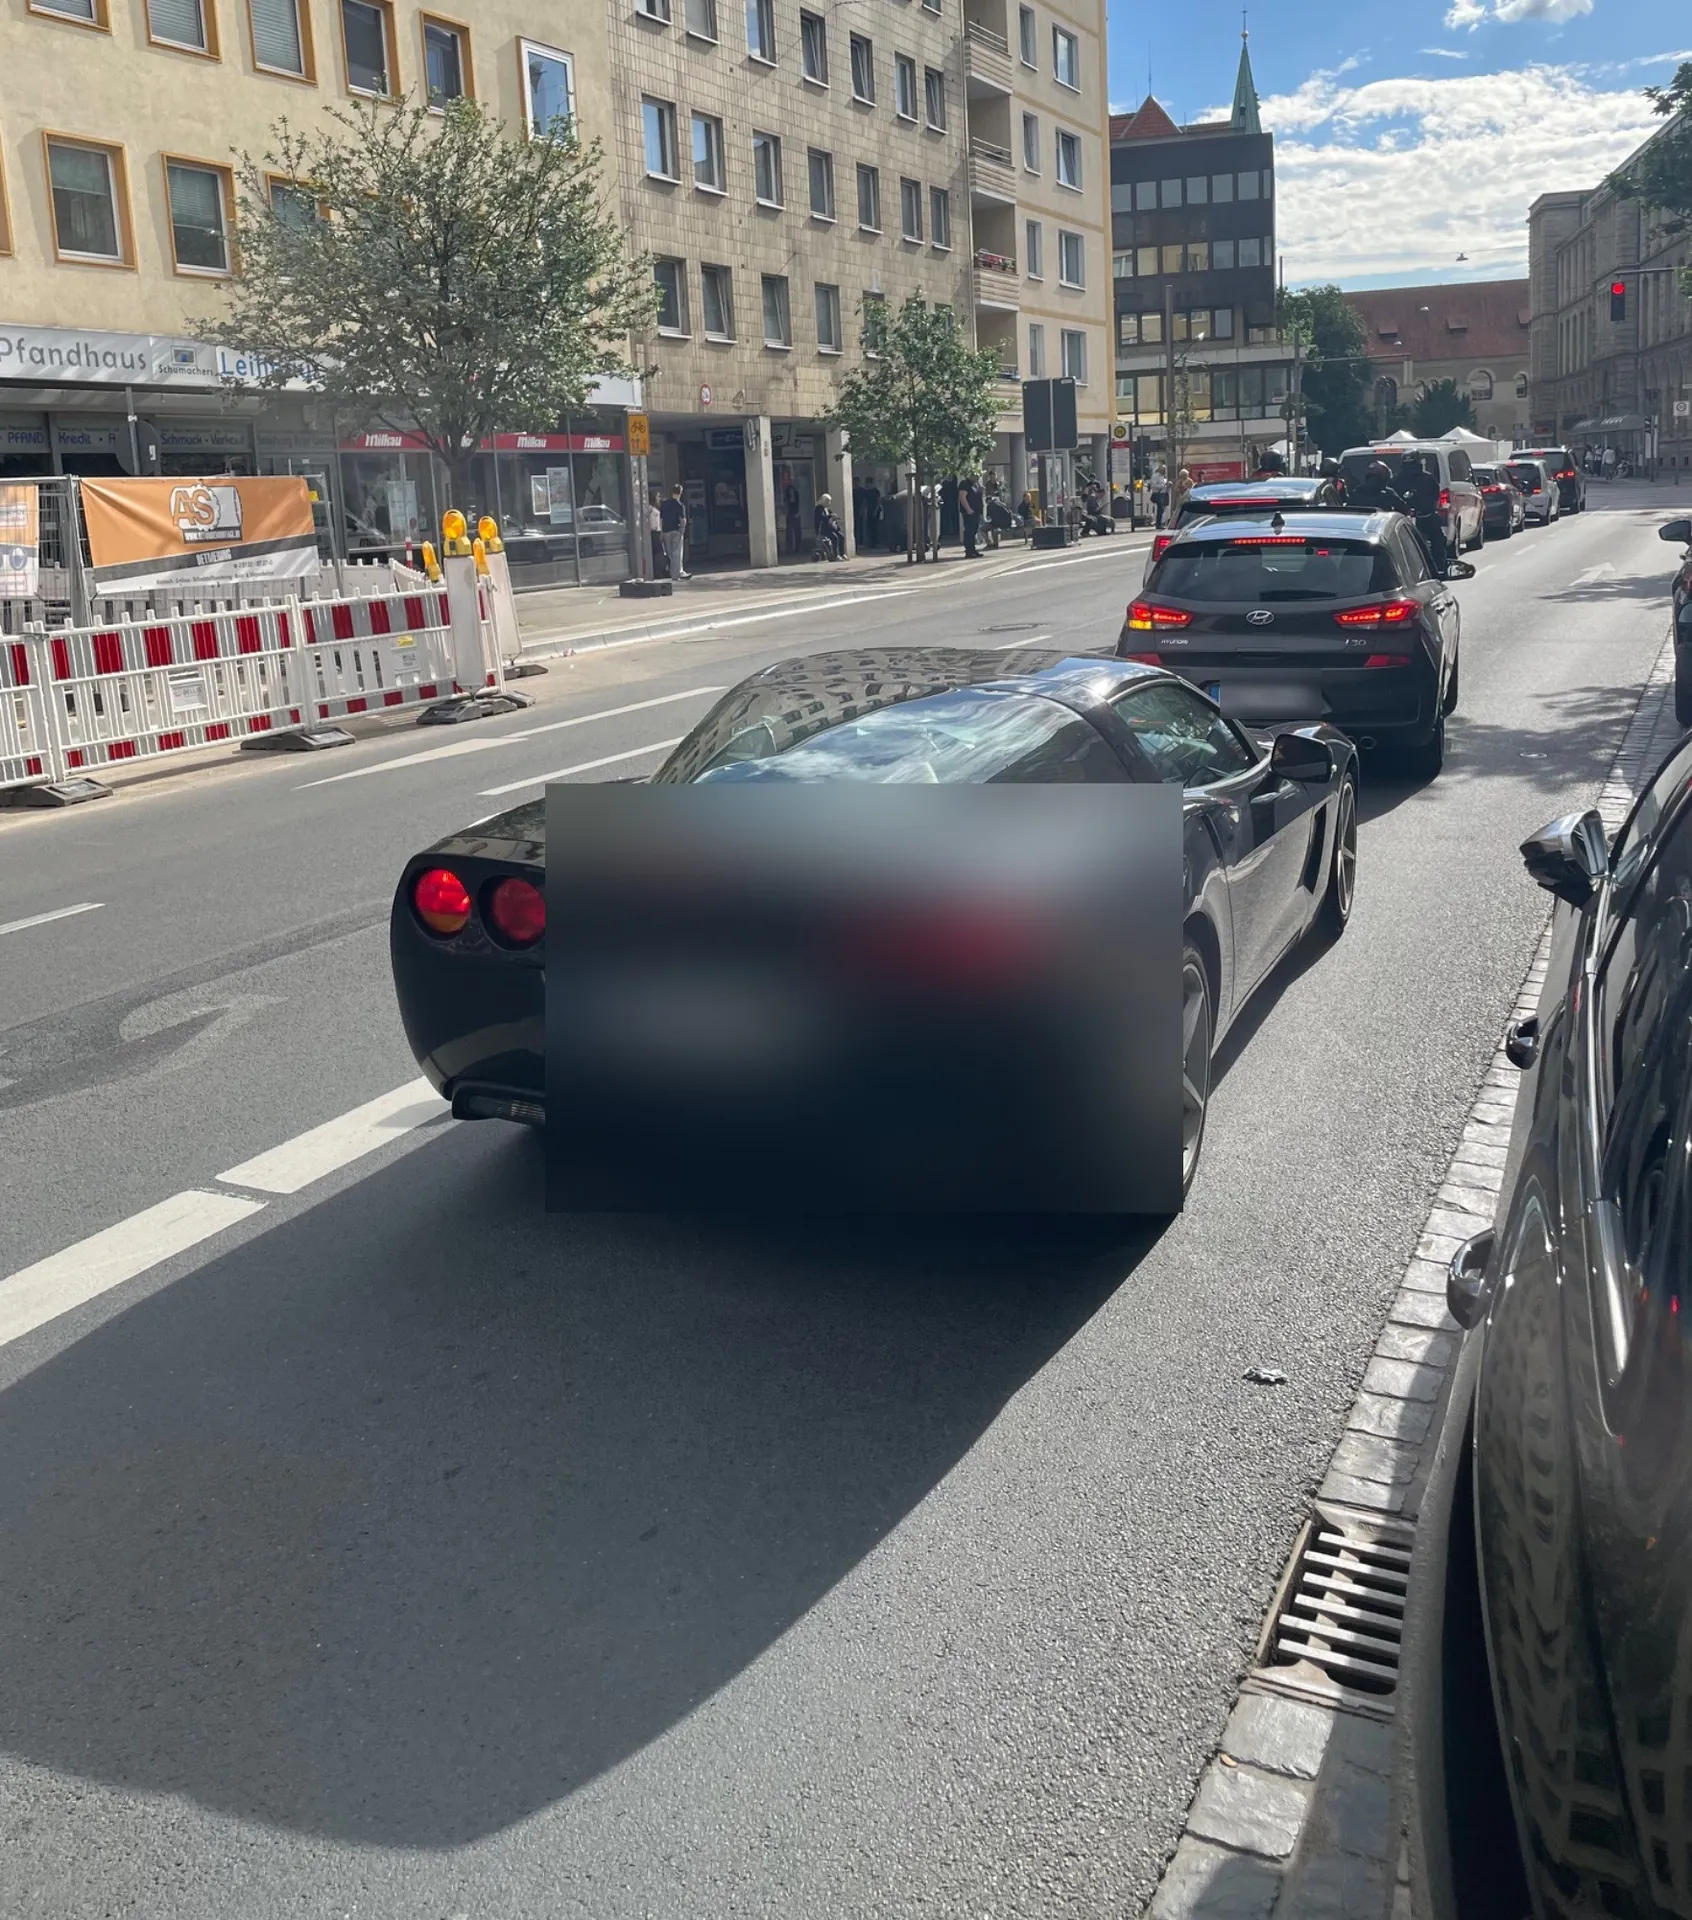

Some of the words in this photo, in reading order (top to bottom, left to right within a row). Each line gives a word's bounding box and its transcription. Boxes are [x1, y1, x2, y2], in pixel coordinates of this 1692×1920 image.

[0, 337, 147, 370] Pfandhaus
[160, 433, 201, 445] Schmuck
[173, 489, 215, 526] AS
